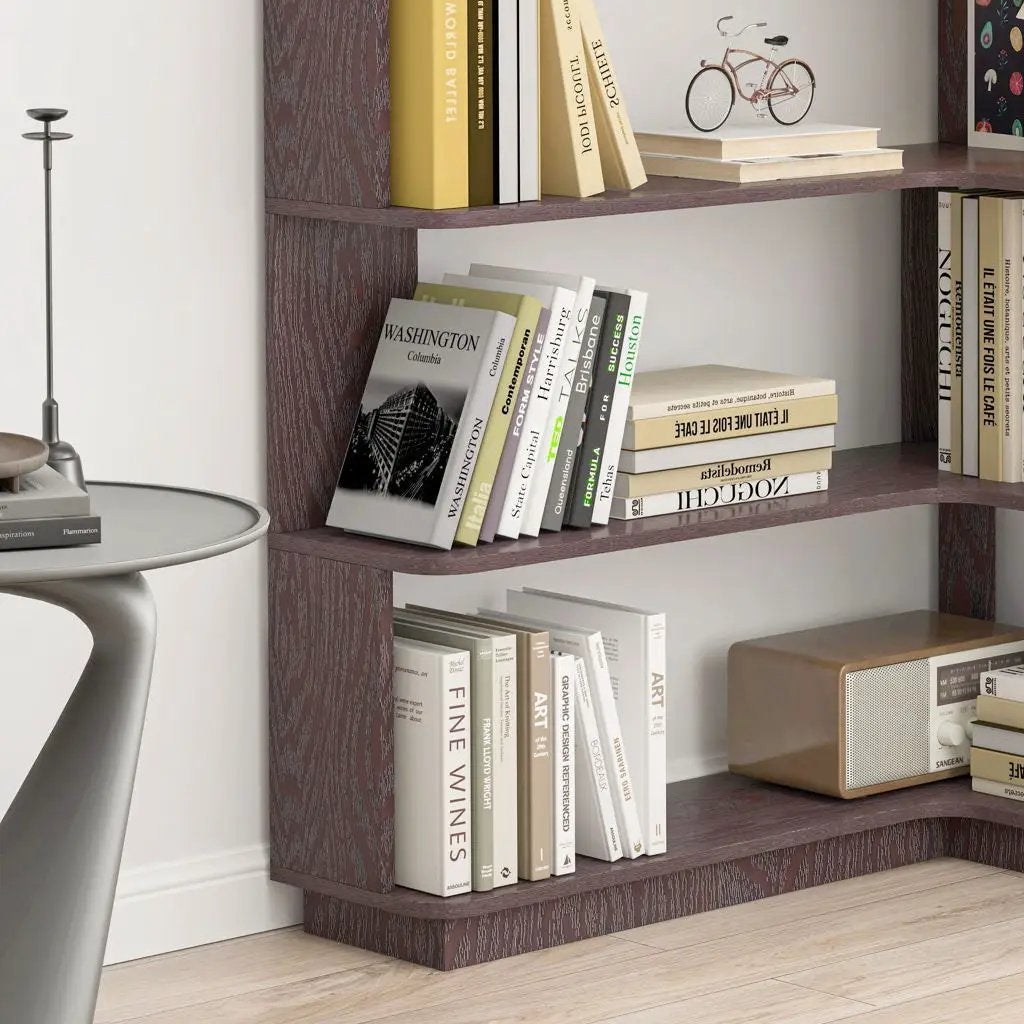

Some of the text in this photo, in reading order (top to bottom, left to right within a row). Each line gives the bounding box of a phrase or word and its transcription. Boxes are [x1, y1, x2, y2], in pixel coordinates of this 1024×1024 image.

[384, 323, 481, 352] WASHINGTON
[407, 350, 442, 365] Columbia
[489, 337, 506, 377] Columbia
[537, 307, 572, 401] Harrisburg
[576, 314, 601, 394] Brisbane
[618, 315, 642, 387] Houston
[939, 247, 952, 400] NOGUCHI
[501, 328, 531, 415] Contemporan
[513, 333, 545, 437] FORM STYLE
[546, 415, 564, 463] TED
[583, 314, 624, 507] FORMULA FOR SUCCESS
[448, 417, 483, 518] WASHINGTON
[511, 430, 540, 519] State Capital
[555, 449, 574, 514] Queensland
[63, 528, 98, 536] Flammarion
[466, 481, 493, 530] Italia
[449, 687, 466, 752] FINE
[534, 692, 548, 729] ART
[651, 672, 664, 708] ART
[483, 718, 492, 810] FRANK LLOYD WRIGHT
[561, 675, 570, 832] GRAPHIC DESIGN REFERENCED
[613, 737, 632, 802] EERO SAARINEN
[936, 756, 964, 769] SANGEAN
[449, 764, 466, 862] WINES
